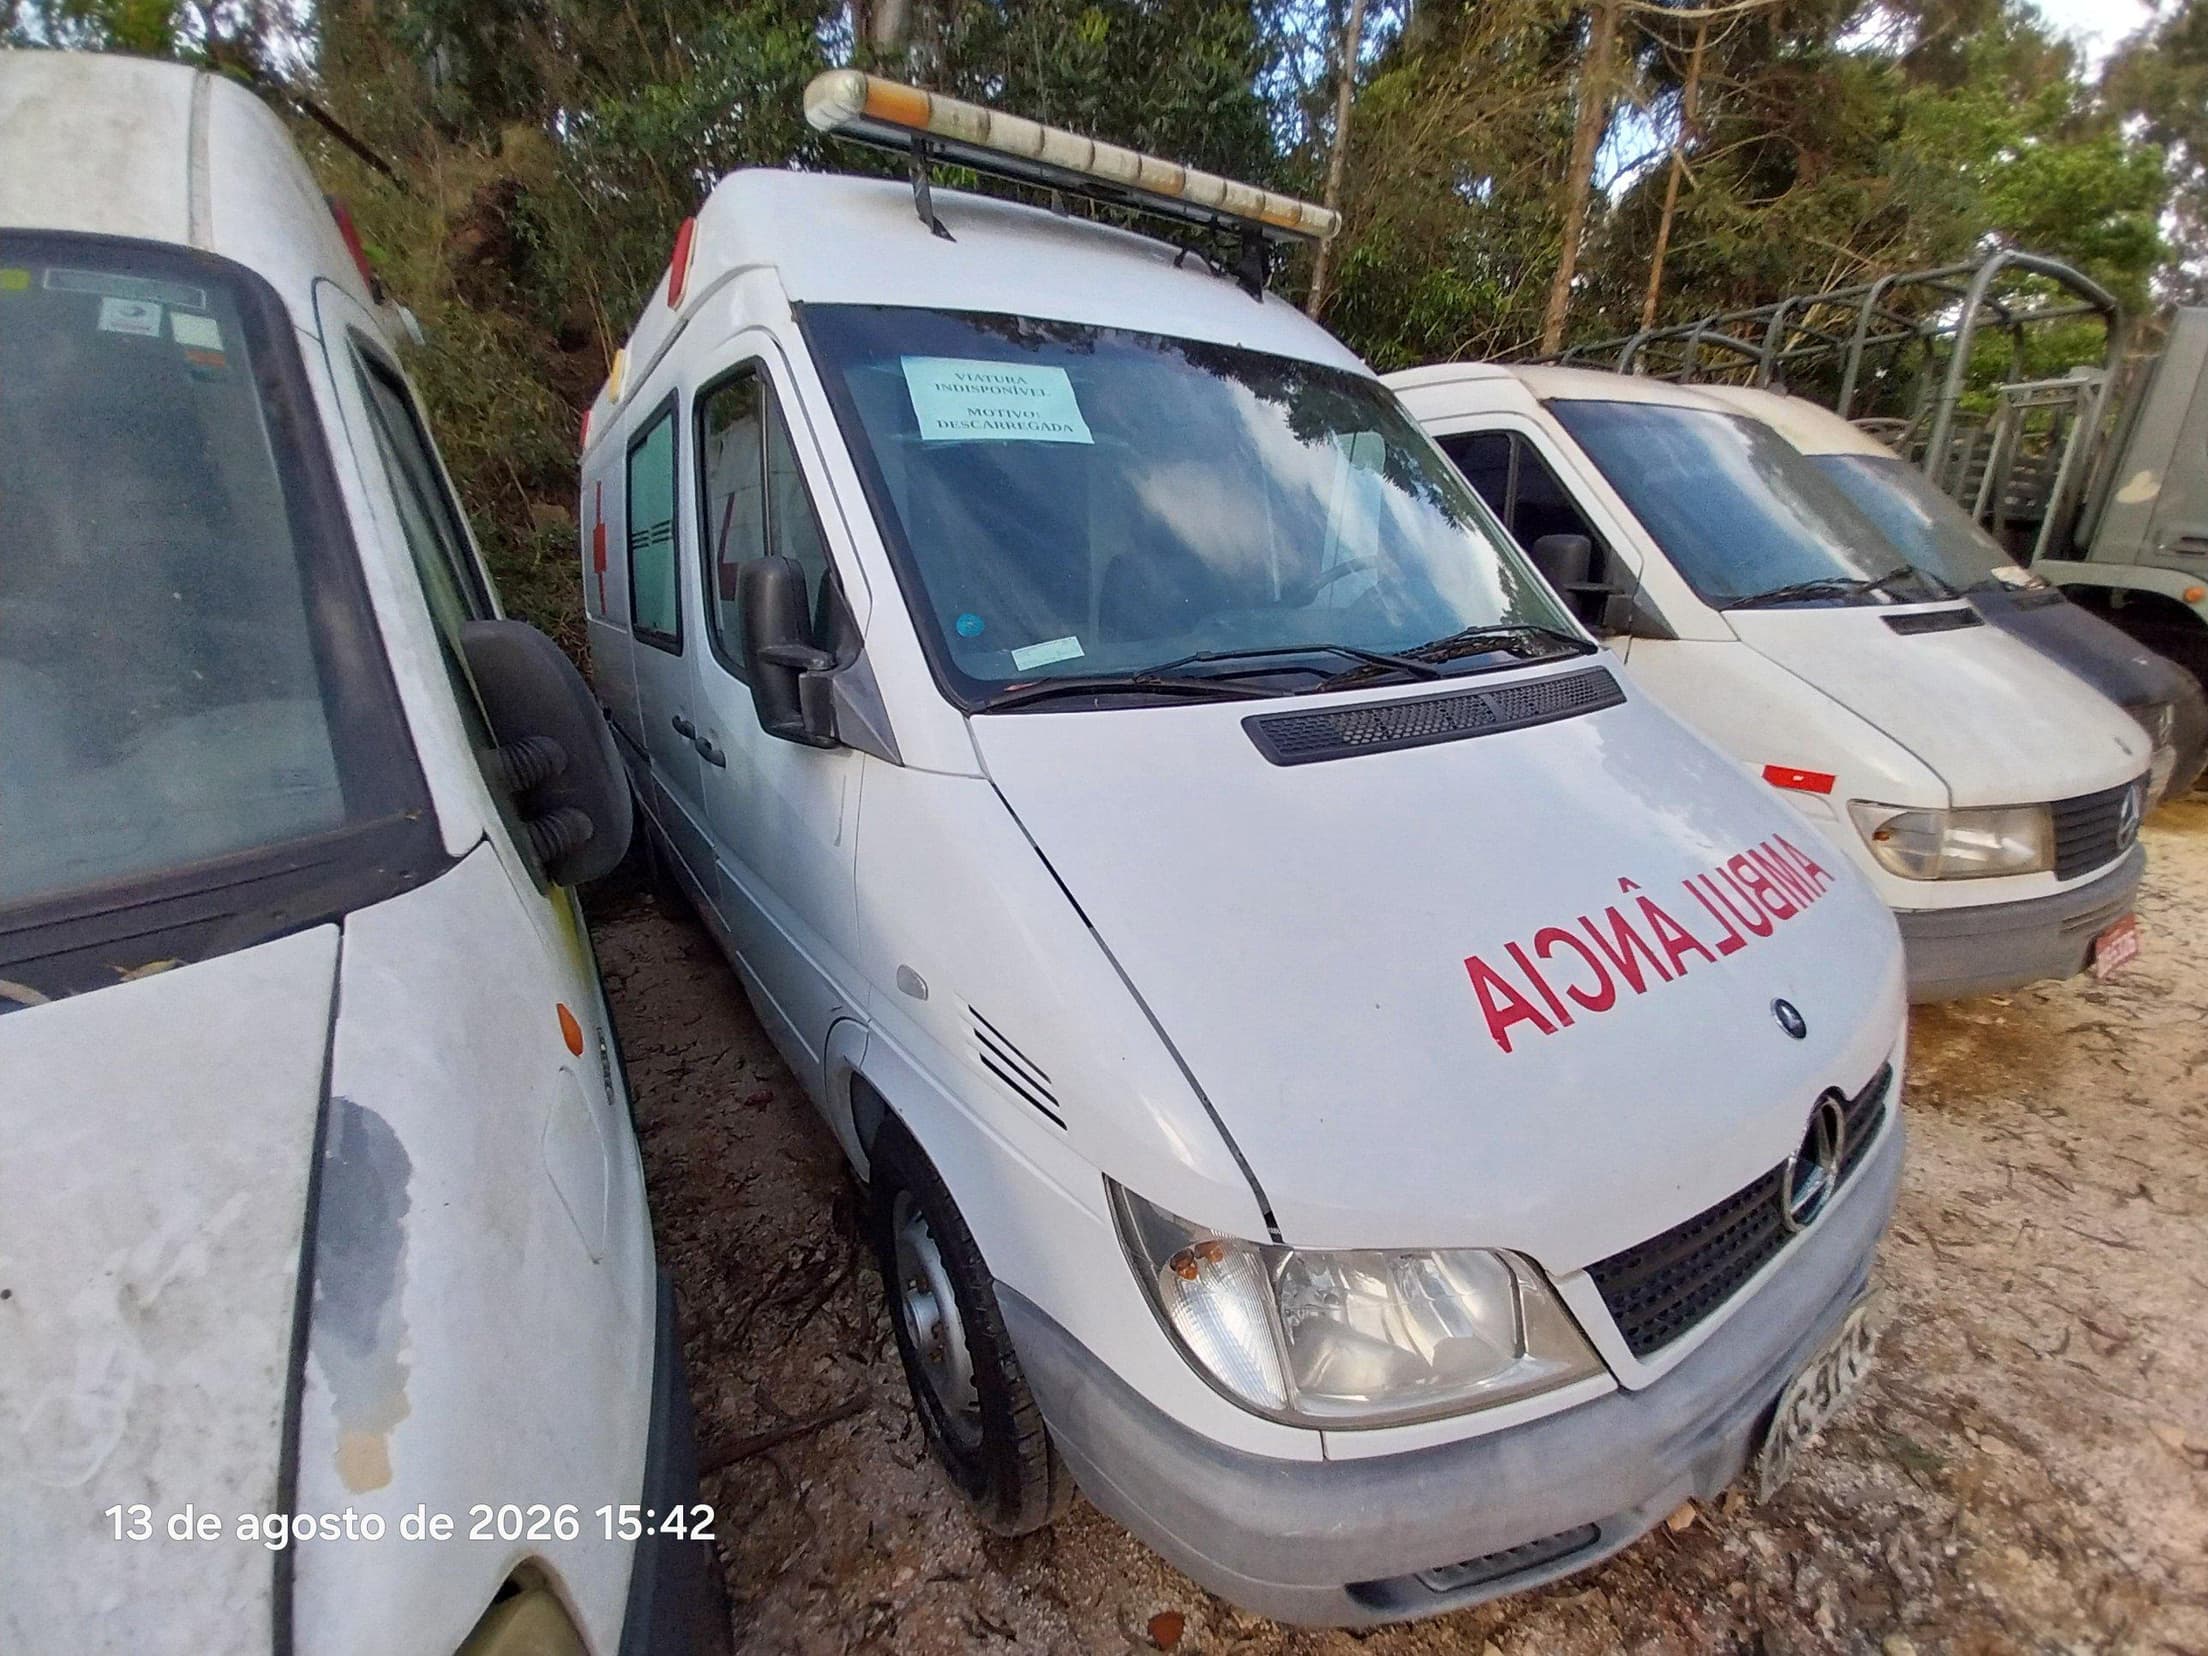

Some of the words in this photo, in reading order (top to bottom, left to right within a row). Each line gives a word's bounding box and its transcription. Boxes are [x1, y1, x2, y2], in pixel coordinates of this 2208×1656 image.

[954, 372, 1028, 385] VIATURA
[935, 382, 1051, 398] INDISPONÍVEL
[937, 419, 1074, 433] DESCARREGADA
